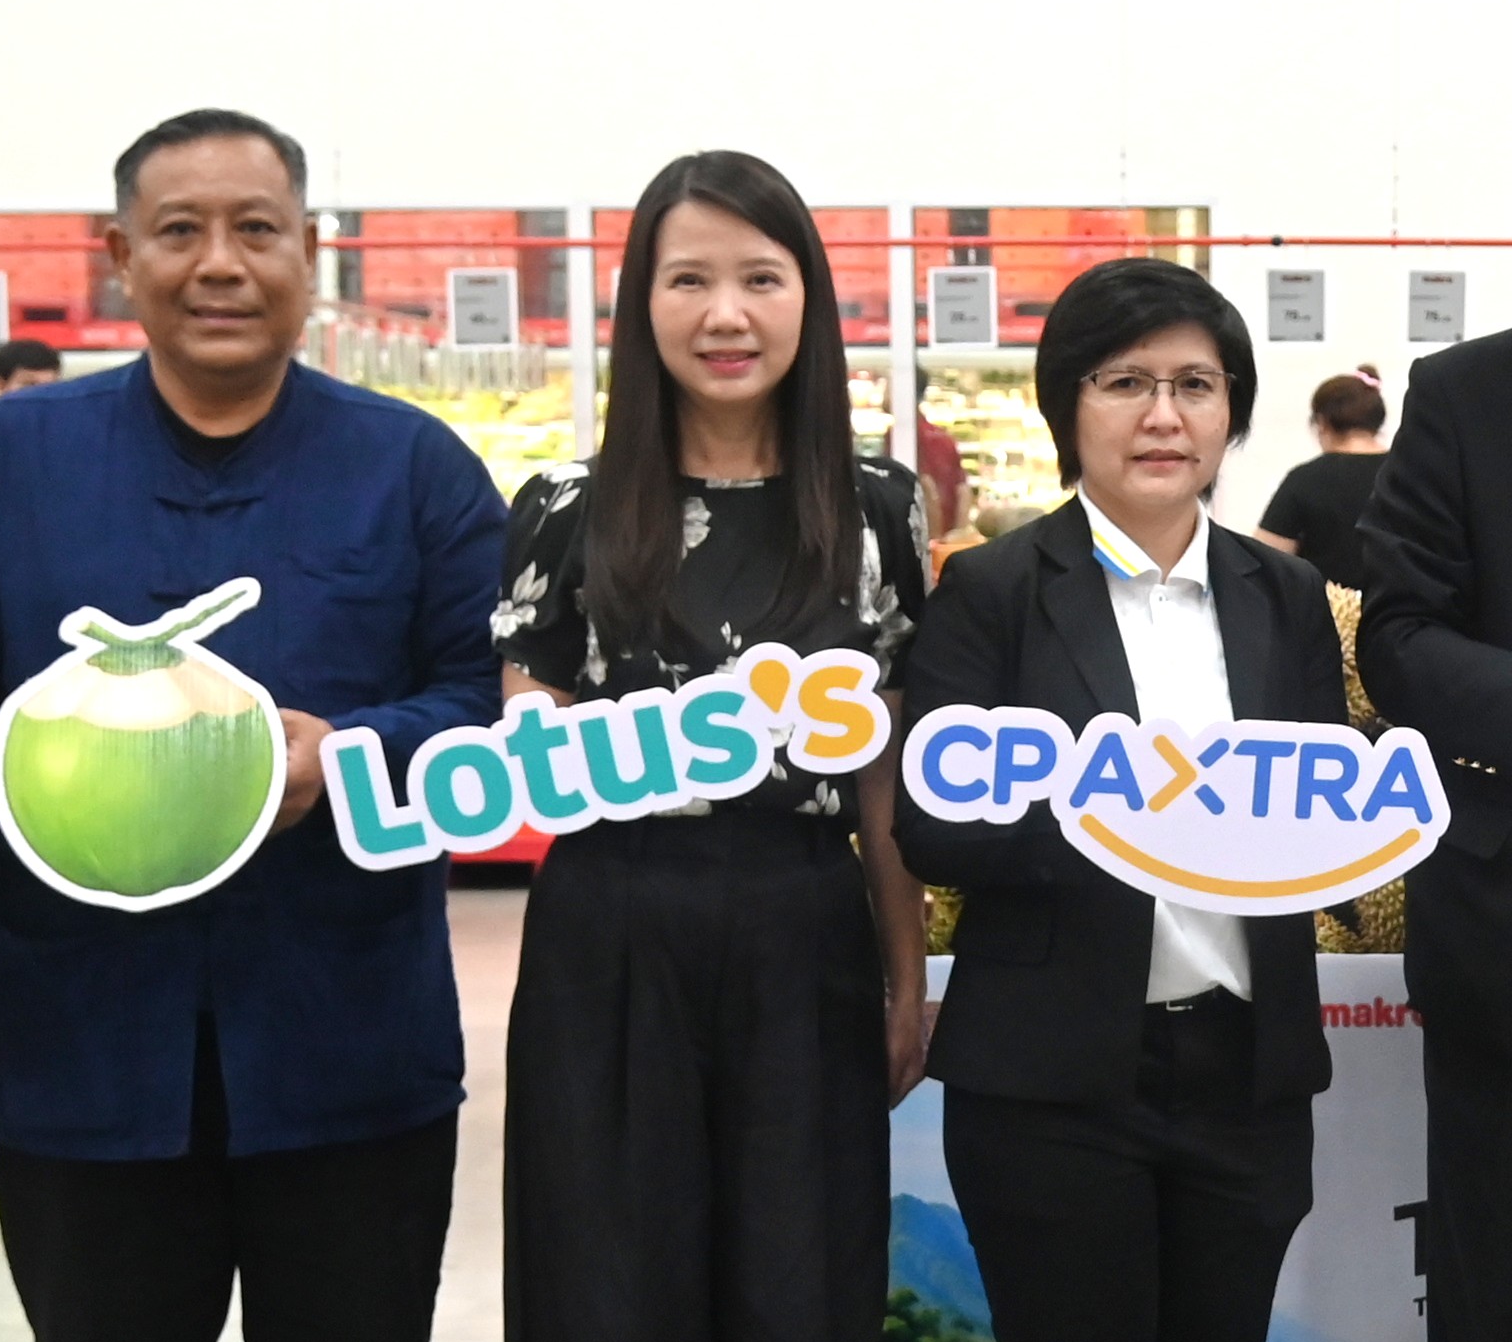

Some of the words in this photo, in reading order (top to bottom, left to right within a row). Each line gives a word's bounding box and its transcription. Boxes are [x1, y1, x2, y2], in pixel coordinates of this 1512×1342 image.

[335, 657, 878, 856] Lotus's
[919, 723, 1059, 804] CP
[1071, 732, 1434, 826] AXTRA
